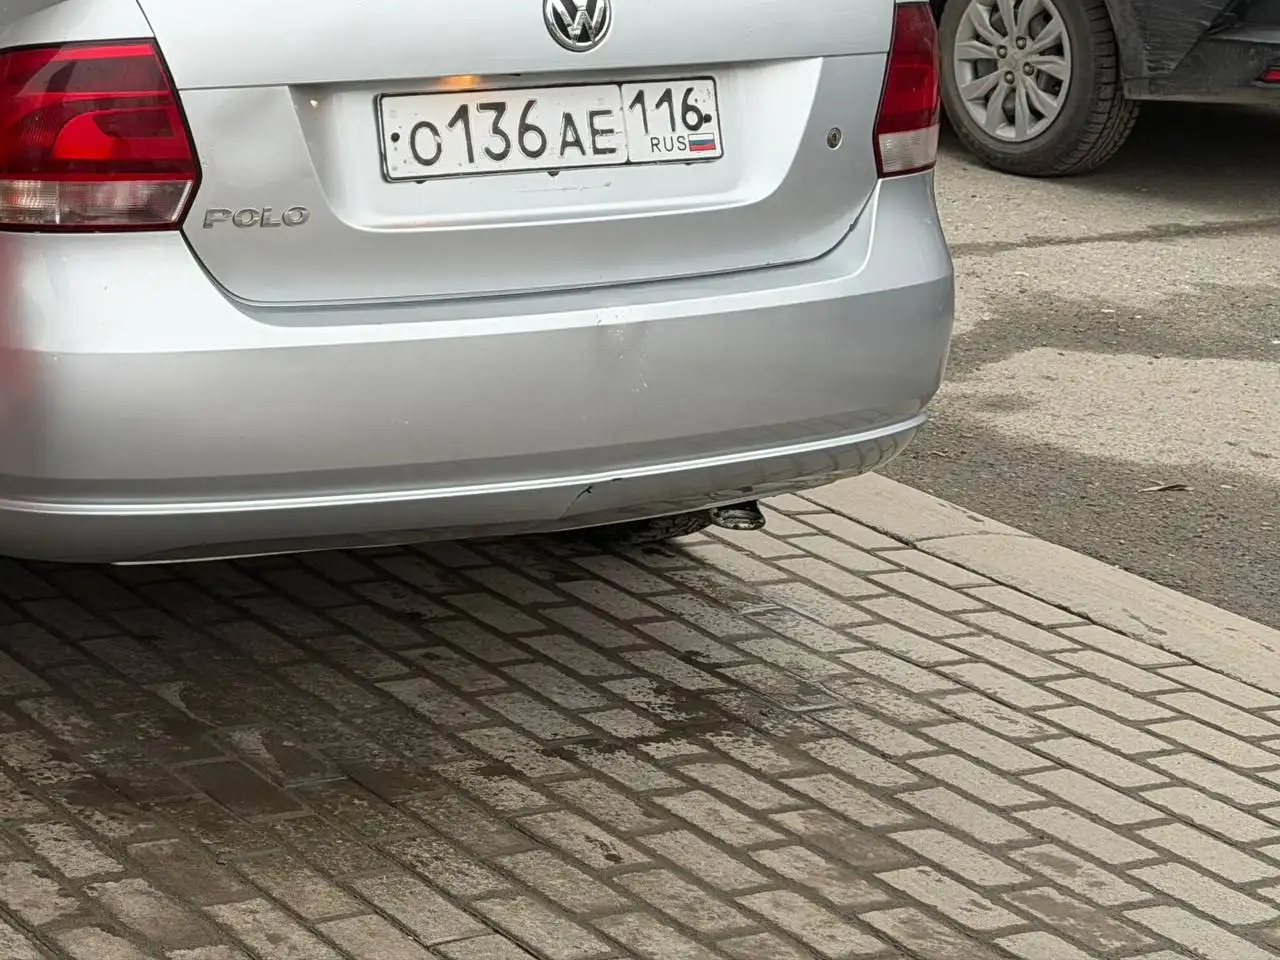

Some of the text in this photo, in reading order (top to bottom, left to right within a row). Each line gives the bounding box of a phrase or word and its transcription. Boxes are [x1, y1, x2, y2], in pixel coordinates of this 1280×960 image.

[629, 86, 704, 133] 116
[650, 134, 688, 153] RUS
[202, 206, 310, 230] POLO
